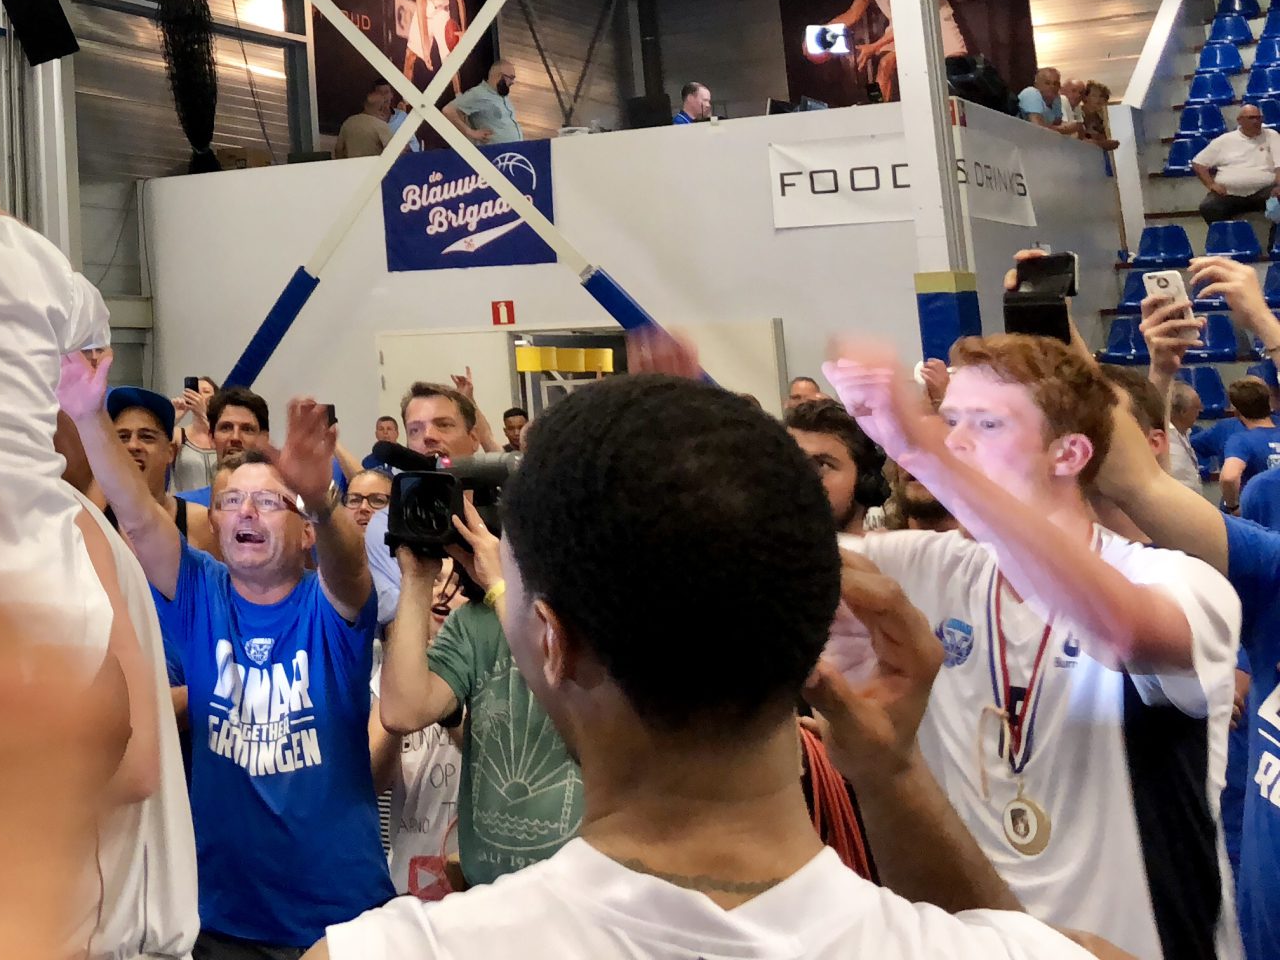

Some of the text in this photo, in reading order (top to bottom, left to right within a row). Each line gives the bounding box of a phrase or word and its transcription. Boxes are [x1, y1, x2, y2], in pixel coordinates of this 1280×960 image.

[428, 171, 444, 184] de
[974, 161, 1027, 197] DRINKS
[400, 174, 490, 213] Blauwe
[429, 762, 457, 789] OP
